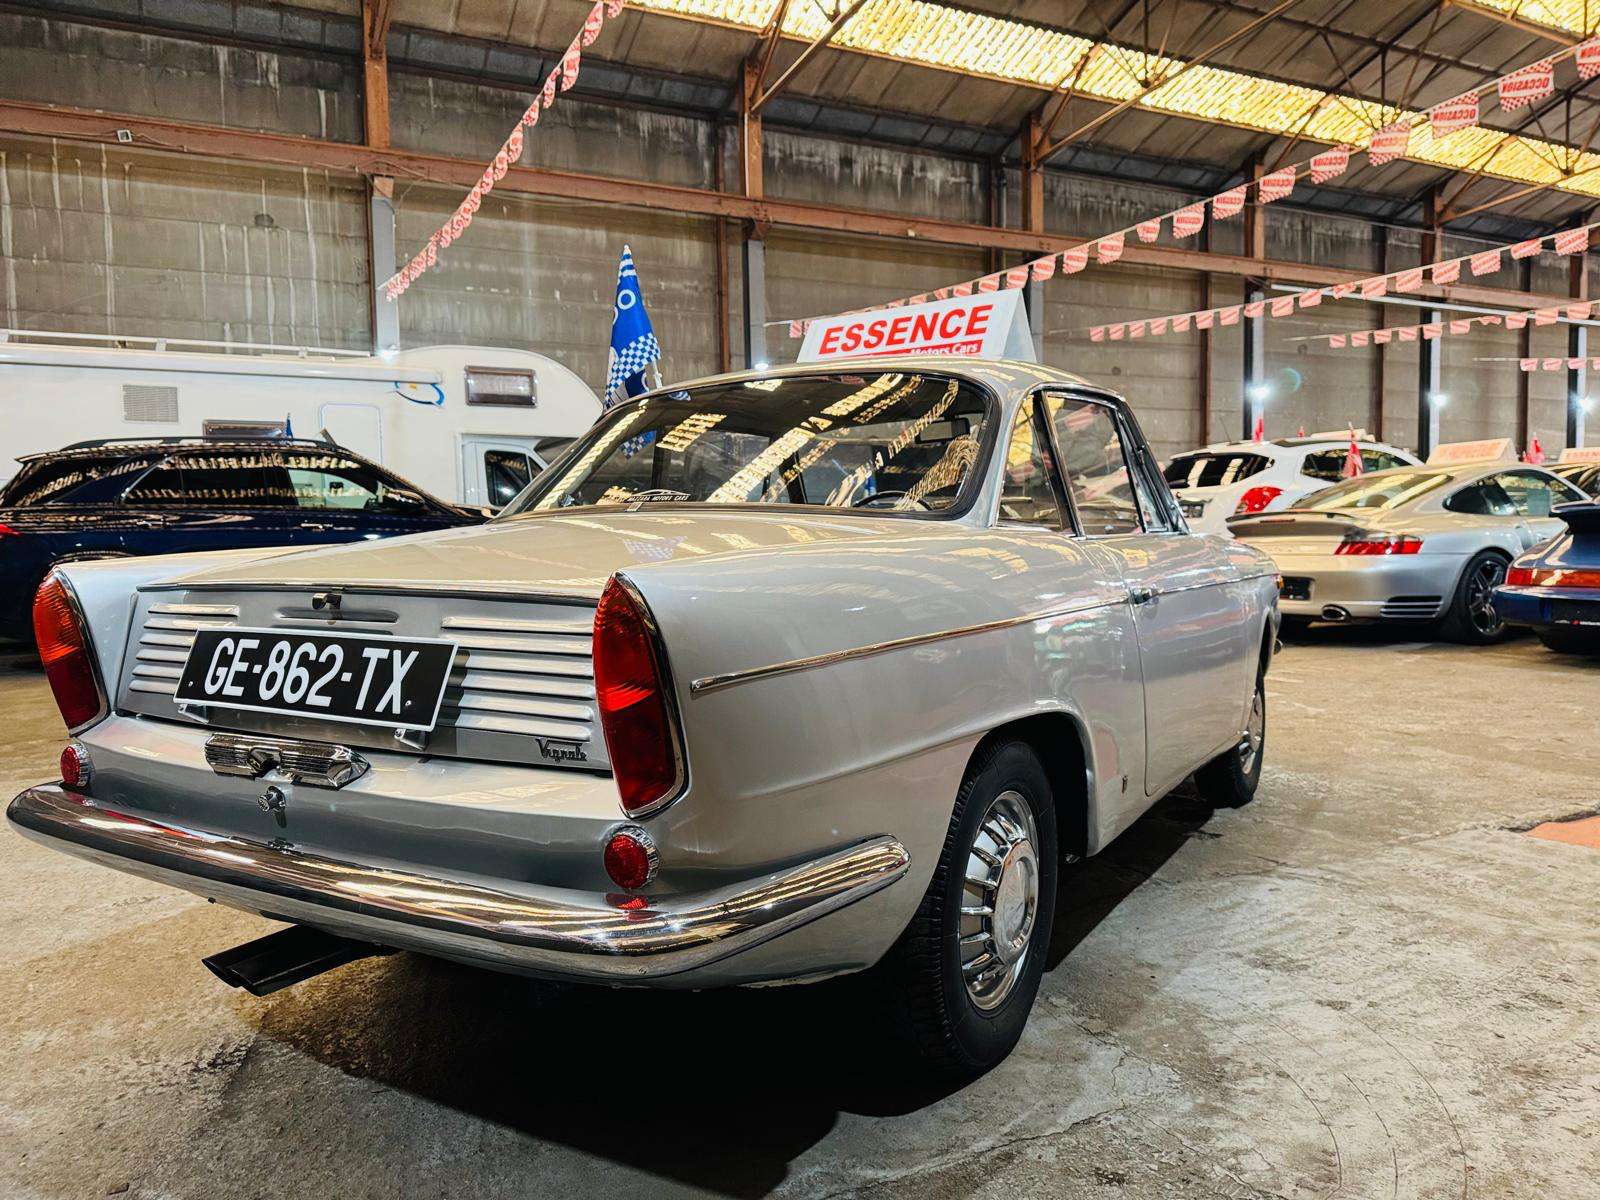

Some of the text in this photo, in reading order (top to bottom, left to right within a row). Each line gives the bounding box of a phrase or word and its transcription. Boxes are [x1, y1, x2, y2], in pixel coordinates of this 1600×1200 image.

[818, 304, 993, 355] ESSENCE
[952, 342, 978, 355] Cars
[204, 637, 420, 715] GE-862-TX
